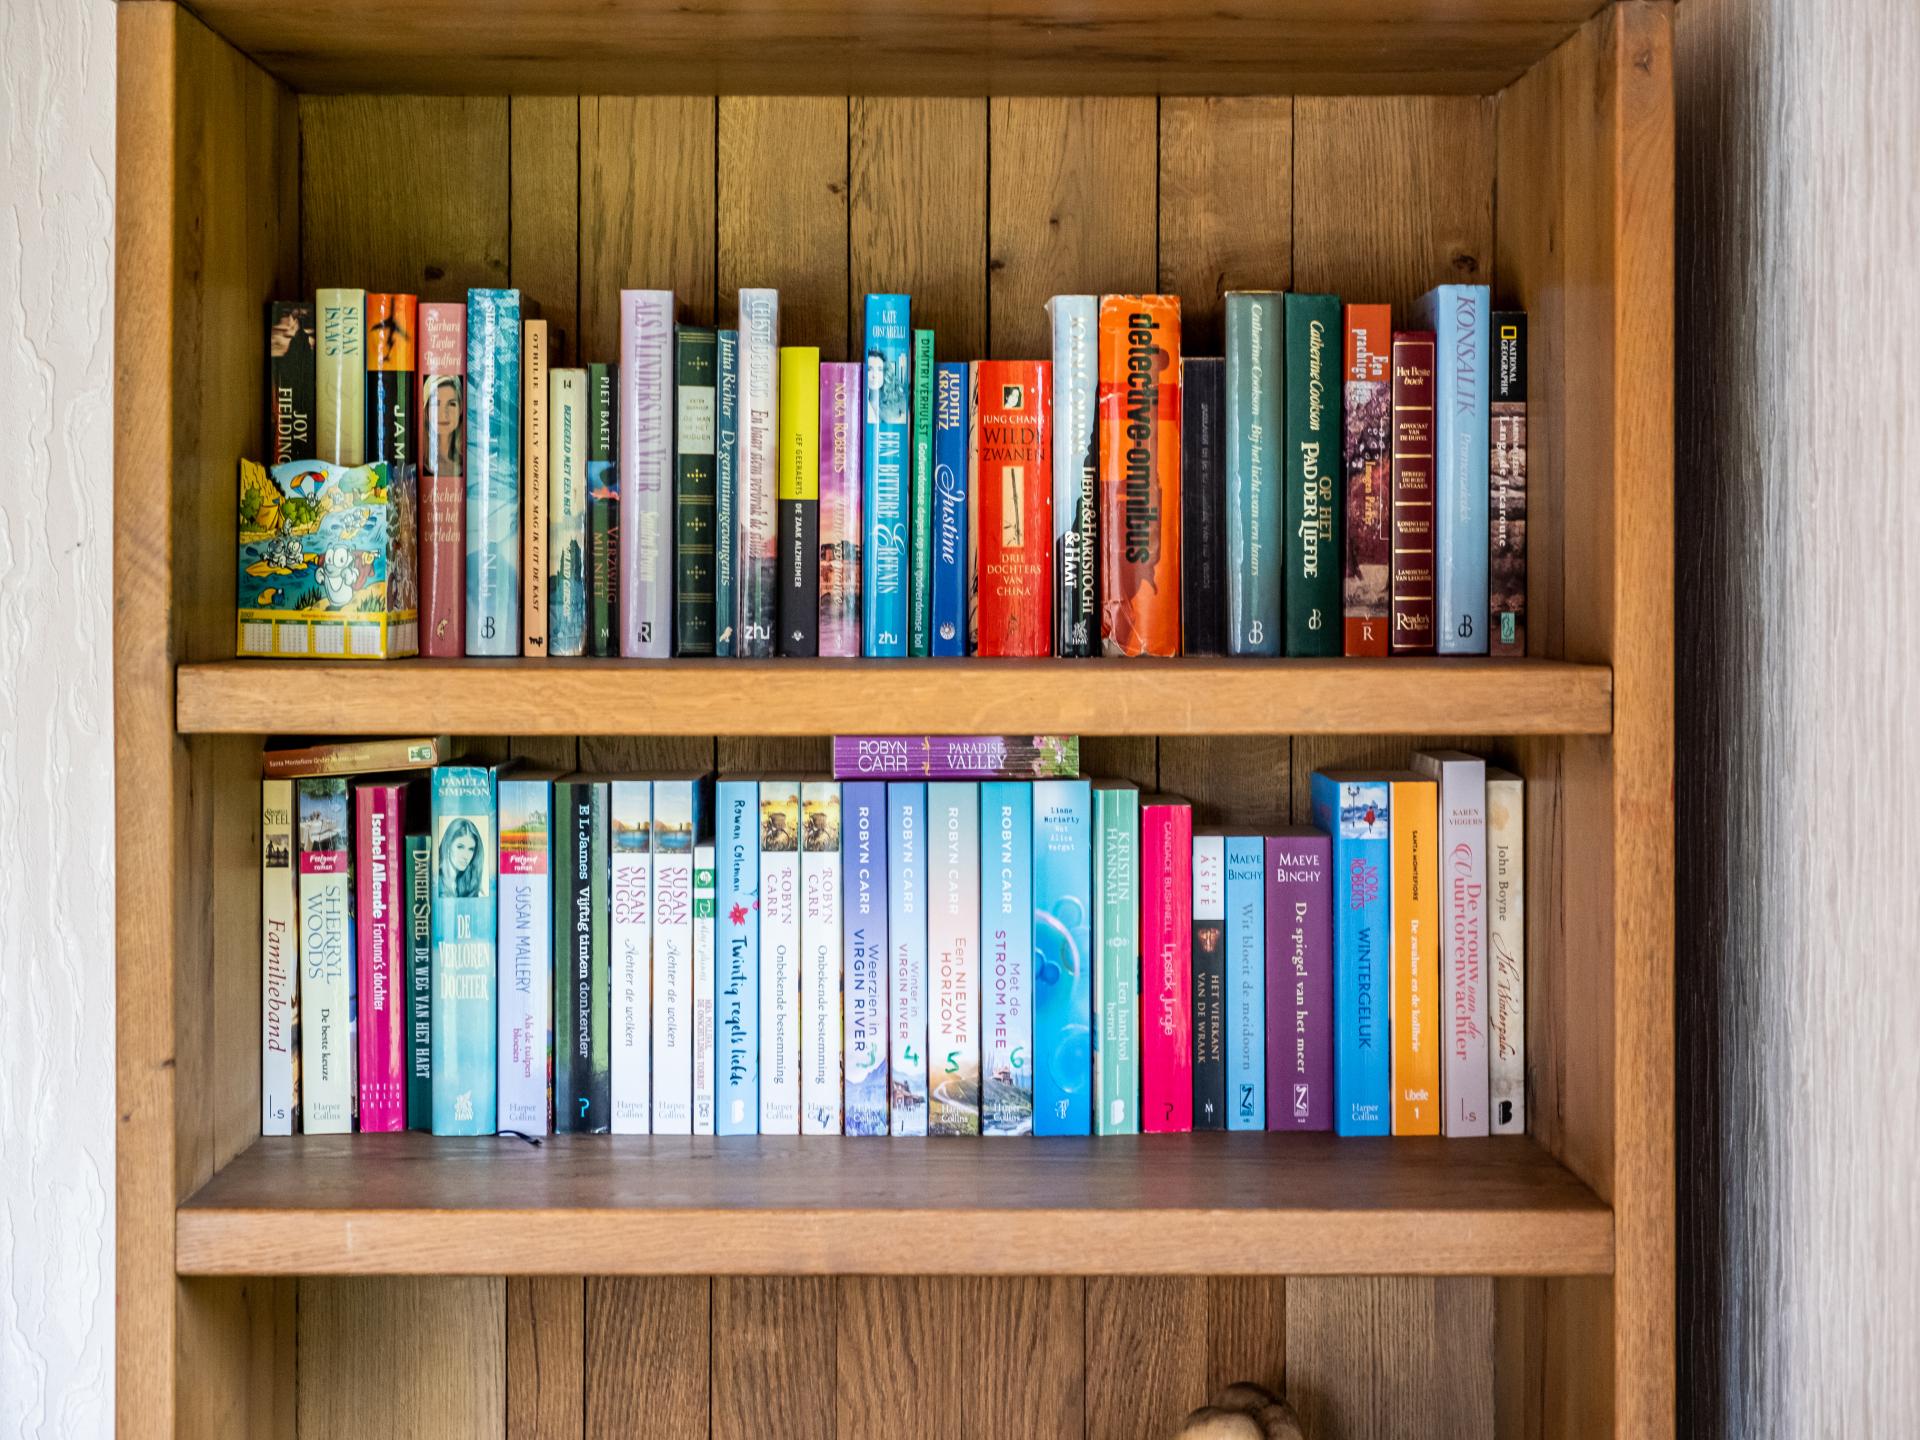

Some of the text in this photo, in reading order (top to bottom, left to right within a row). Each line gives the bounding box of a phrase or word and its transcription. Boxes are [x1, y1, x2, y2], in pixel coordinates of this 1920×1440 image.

[325, 307, 340, 357] ISAACS
[342, 307, 358, 356] SUSAN
[427, 319, 461, 333] Barbara
[431, 335, 456, 351] Taylor
[872, 326, 906, 338] COSCARELLI
[882, 310, 896, 325] KATE
[1309, 320, 1324, 430] Catherine Cookson
[1352, 329, 1369, 379] prachtige
[1372, 356, 1388, 375] Een
[1397, 366, 1430, 376] Het Beste
[1404, 378, 1424, 386] boek
[1456, 295, 1475, 417] KONSALIK
[1500, 339, 1509, 396] GEOGRAPHIC
[601, 377, 609, 451] PIET BAETE
[919, 339, 931, 436] DIMITRI VERHULST
[938, 370, 949, 430] KRANTZ
[948, 374, 960, 427] JUDITH
[293, 410, 308, 443] JOY
[982, 448, 1045, 461] ZWANEN
[1126, 313, 1159, 564] detective-omnibus
[718, 338, 736, 586] Jutta Richter De geraniumgevangenis
[795, 503, 802, 514] DE
[875, 432, 906, 594] EEN BITTERE ERFENIS
[935, 464, 965, 565] Justine
[1298, 441, 1319, 579] PAD DER LIEFDE
[1319, 476, 1332, 542] OP HET
[607, 527, 618, 603] VERZWIJG
[794, 541, 802, 588] ALZHEIMER
[1003, 576, 1024, 584] VAN
[878, 630, 898, 645] zhu
[1363, 626, 1374, 641] R
[858, 754, 908, 772] CARR
[859, 740, 908, 755] ROBYN
[946, 754, 1006, 770] VALLEY
[1044, 816, 1080, 824] Moriarty
[858, 807, 870, 914] ROBYN CARR
[902, 806, 913, 913] ROBYN CARR
[948, 807, 959, 914] ROBYN CARR
[1001, 806, 1012, 913] ROBYN CARR
[1106, 827, 1118, 905] HANNAH
[1118, 832, 1129, 900] KRISTIN
[1200, 854, 1211, 905] ASPE
[1228, 869, 1262, 880] BINCHY
[1229, 854, 1261, 864] MAEVE
[1277, 869, 1320, 882] BINCHY
[1280, 853, 1319, 866] MAEVE
[1350, 858, 1364, 910] ROBERTS
[1364, 866, 1377, 902] NORA
[371, 813, 386, 1011] Isabel Allende Fortuna's dochter
[615, 868, 630, 925] WIGGS
[630, 867, 645, 925] SUSAN
[658, 868, 672, 925] WIGGS
[672, 867, 687, 925] SUSAN
[766, 874, 778, 918] CARR
[780, 867, 793, 924] ROBYN
[807, 874, 819, 919] CARR
[822, 867, 833, 924] ROBYN
[308, 894, 324, 980] WOODS
[322, 886, 341, 985] SHERRYL
[515, 886, 531, 994] SUSAN MALLERY
[575, 804, 590, 1058] E L James Vijftig tinten donkerder
[1159, 821, 1176, 1036] CANDACE BUSHNELL Lipstick Jungle
[268, 919, 286, 1053] Familieband
[413, 850, 432, 1079] DANIELLE STEEL DE WEG VAN HET HART
[854, 929, 865, 1052] VIRGIN RIVER
[867, 944, 880, 1036] Weerzien in
[898, 944, 909, 1039] VIRGIN RIVER
[910, 961, 919, 1017] Winter in
[955, 938, 967, 1044] Een NIEUWE
[995, 930, 1007, 1049] STROOM MEE
[1009, 963, 1021, 1016] Met de
[1242, 904, 1254, 1071] Wit bloeit de meidoorn
[1292, 902, 1308, 1074] De spiegel van het meer
[1358, 927, 1371, 1048] WINTERGELUK
[774, 945, 786, 1084] Onbekende bestemming
[816, 945, 828, 1084] Onbekende bestemming
[941, 952, 952, 1035] HORIZON
[1107, 1002, 1117, 1041] hemel
[1118, 981, 1129, 1062] Een handvol
[1197, 972, 1207, 1064] VAN DE WRAAK
[1210, 975, 1219, 1062] HET VIERKANT
[321, 1009, 330, 1081] De beste keuze
[903, 1045, 919, 1067] 4
[945, 1051, 962, 1073] 5
[1009, 1046, 1024, 1069] 6
[1404, 1089, 1429, 1101] Libelle
